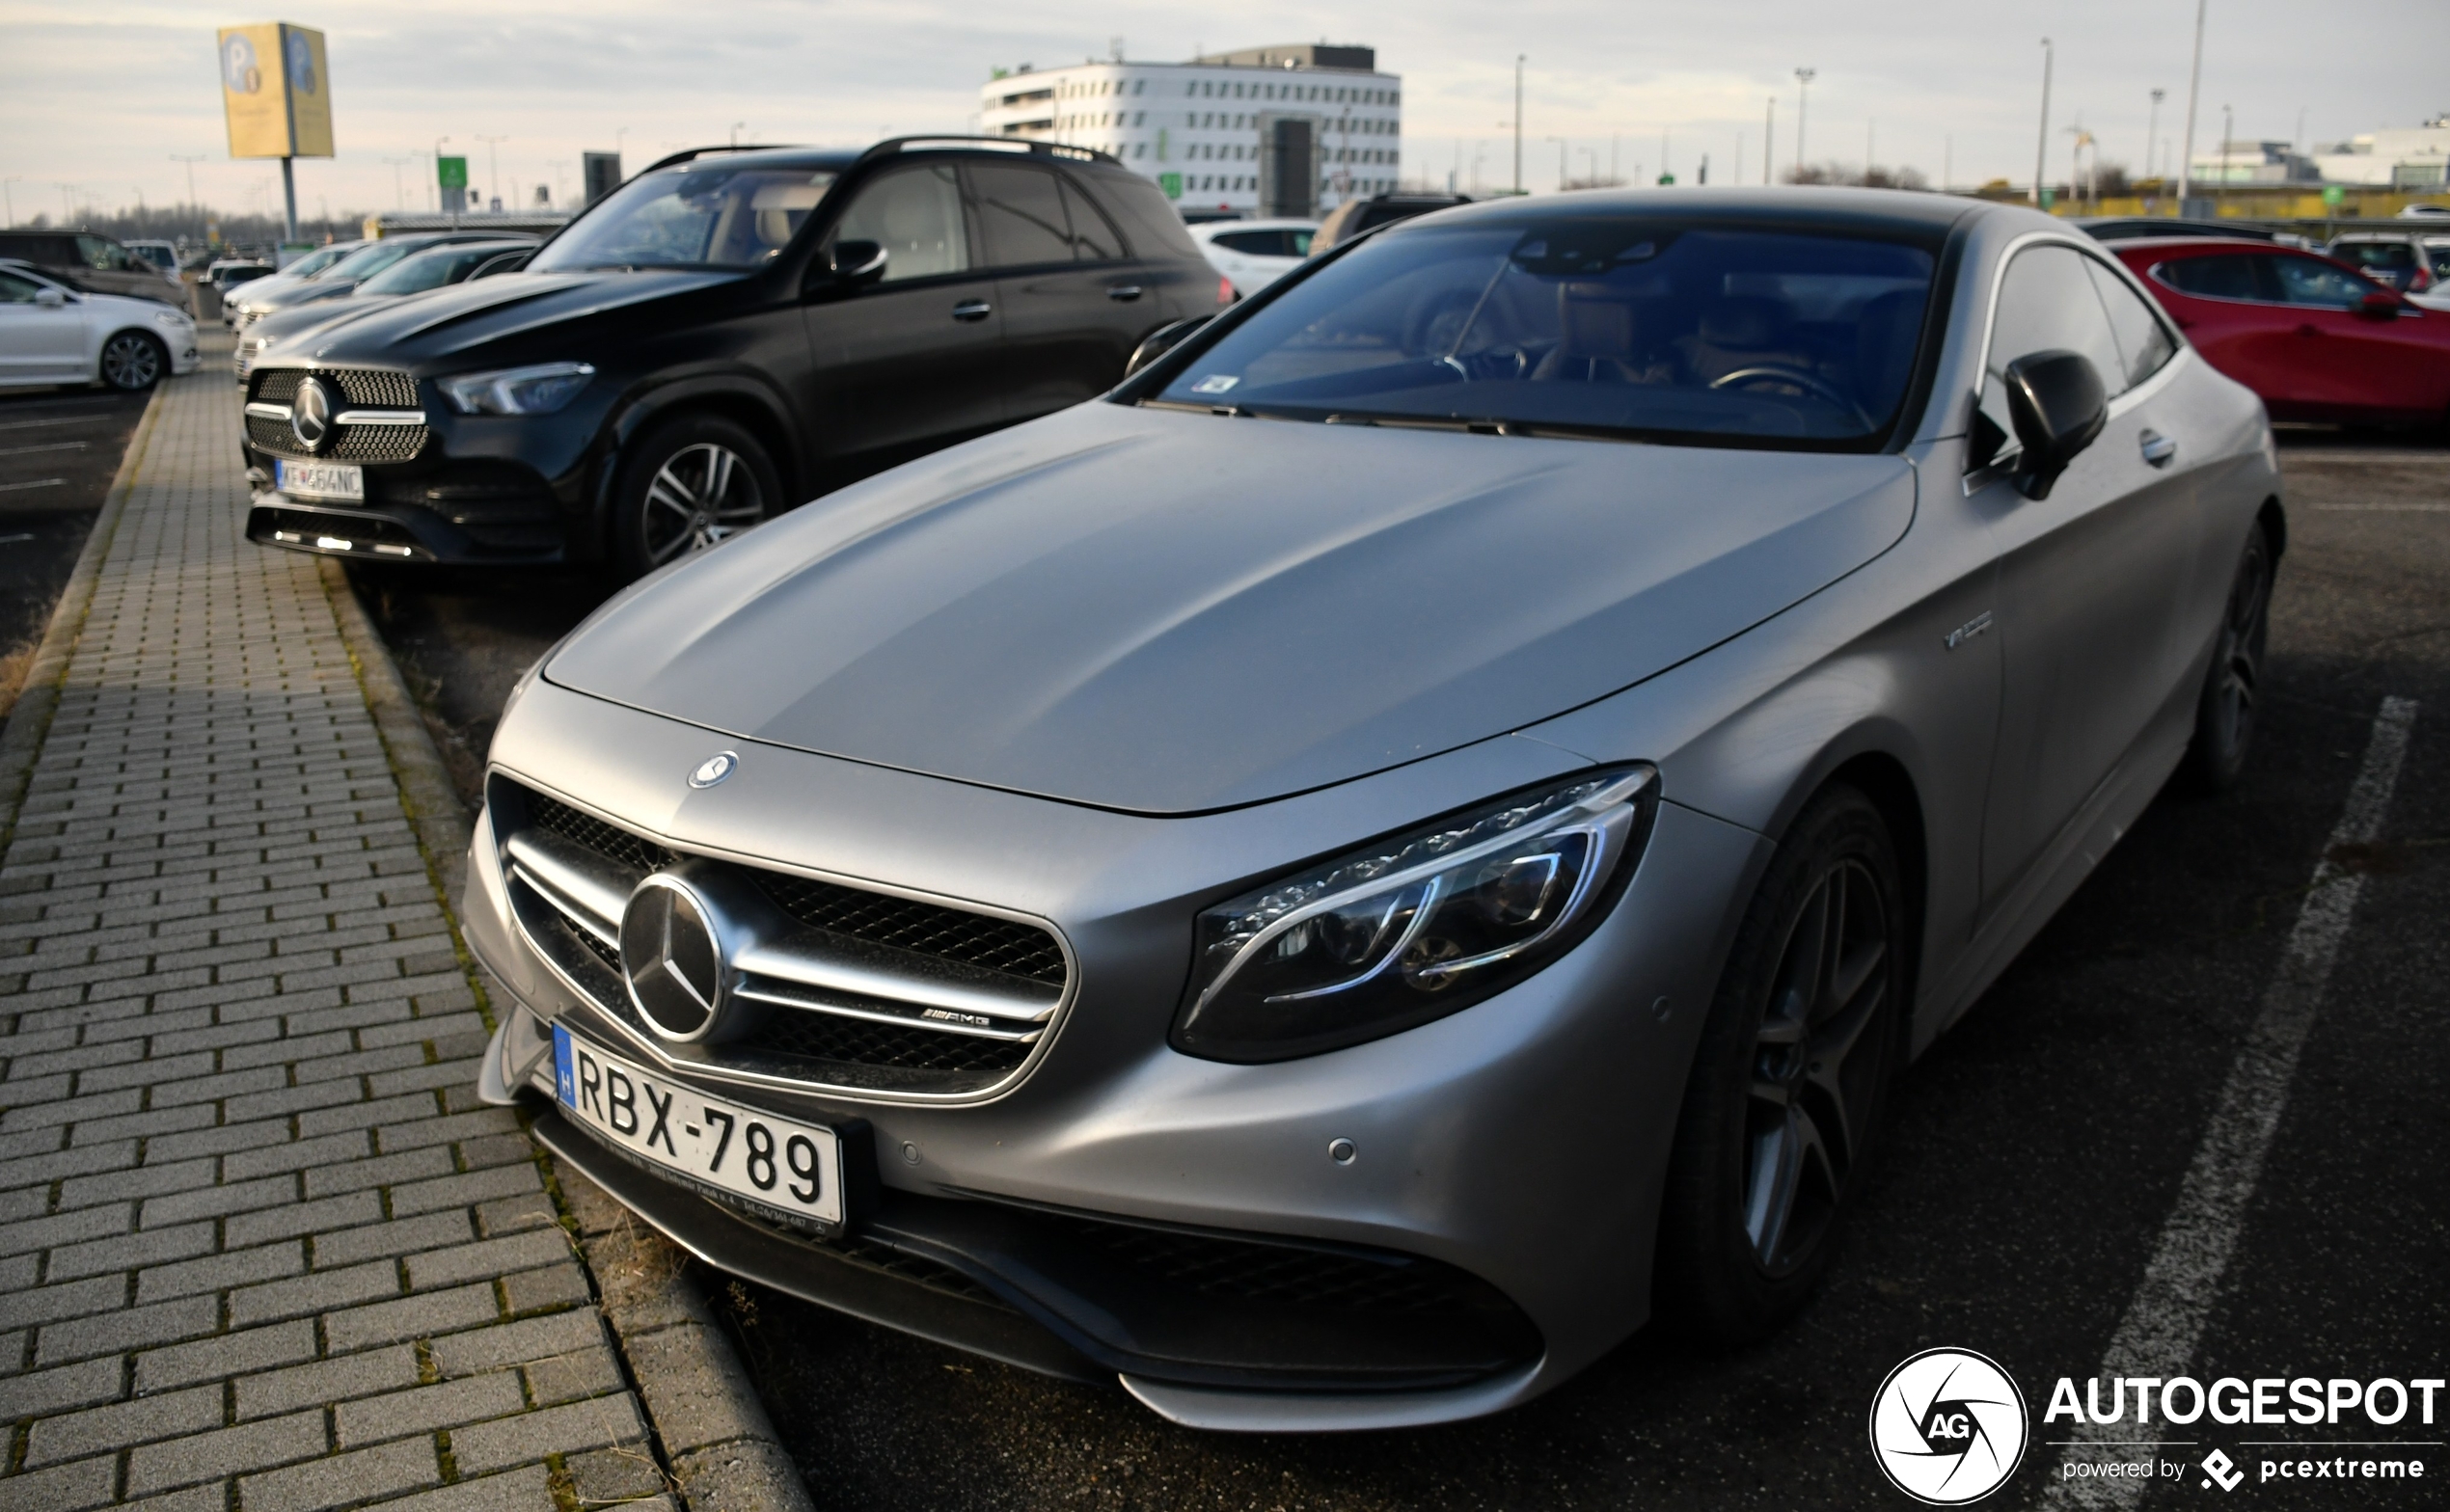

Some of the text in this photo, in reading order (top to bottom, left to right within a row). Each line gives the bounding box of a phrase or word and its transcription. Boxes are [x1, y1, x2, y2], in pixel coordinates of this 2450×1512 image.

[231, 42, 247, 79] P
[560, 1069, 572, 1096] H
[579, 1049, 821, 1204] RBX-789
